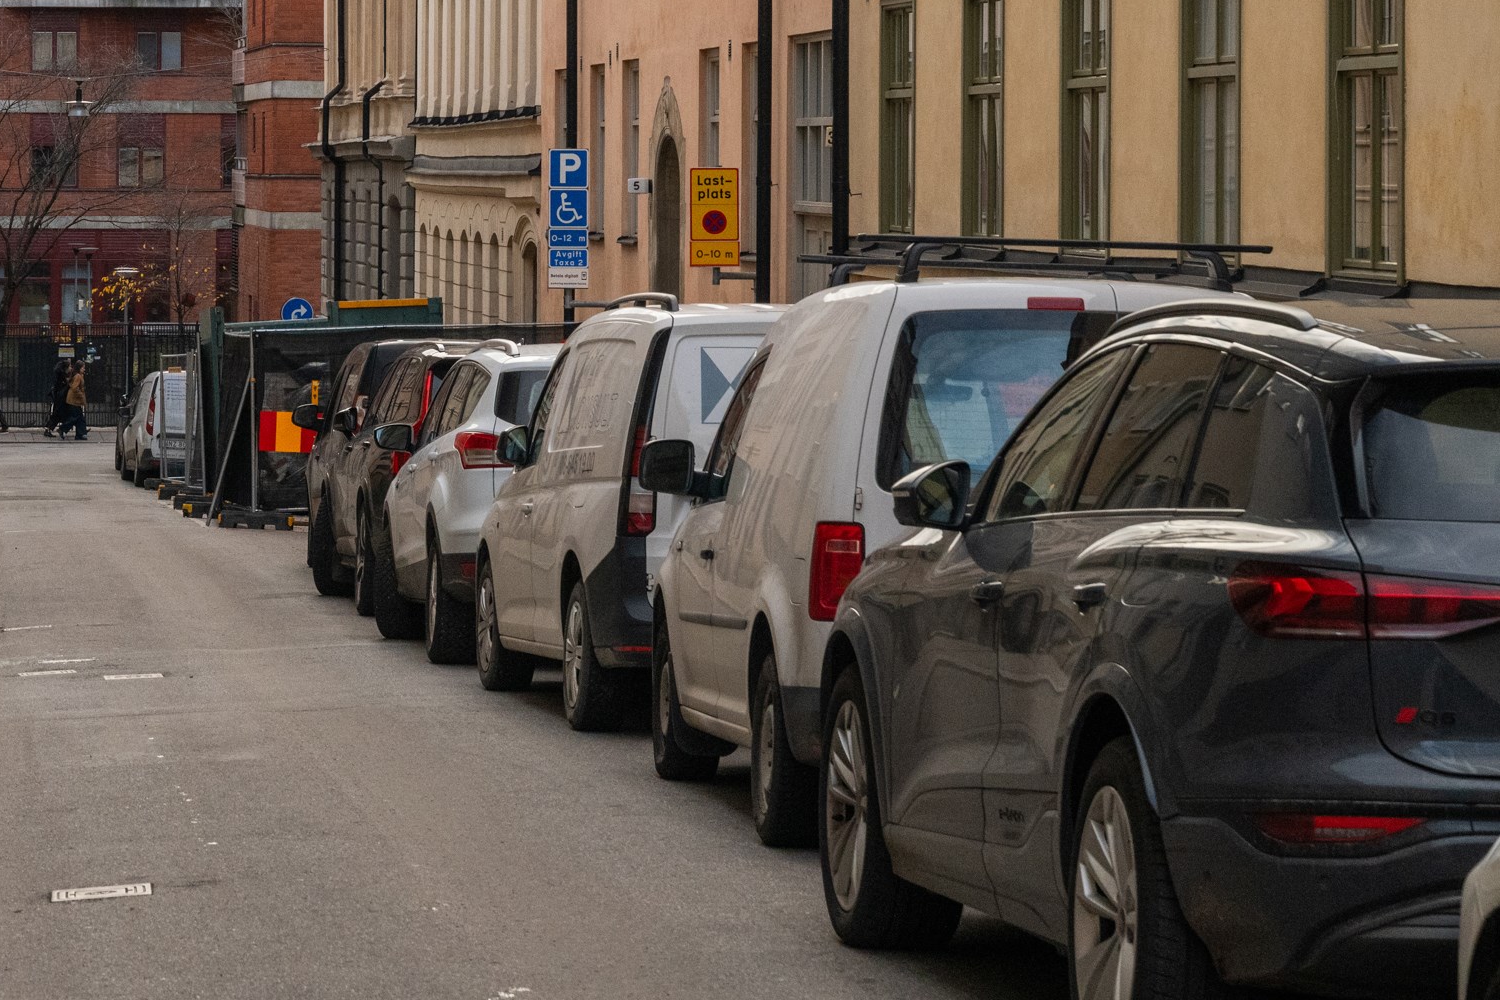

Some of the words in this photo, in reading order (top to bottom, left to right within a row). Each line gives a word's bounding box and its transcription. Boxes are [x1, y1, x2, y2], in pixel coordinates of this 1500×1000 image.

[559, 152, 582, 184] P
[697, 175, 733, 186] Last-
[633, 181, 640, 190] 5
[698, 188, 732, 201] plats
[551, 234, 572, 242] 0-12
[555, 250, 582, 259] Avgift
[696, 249, 721, 258] 0-10
